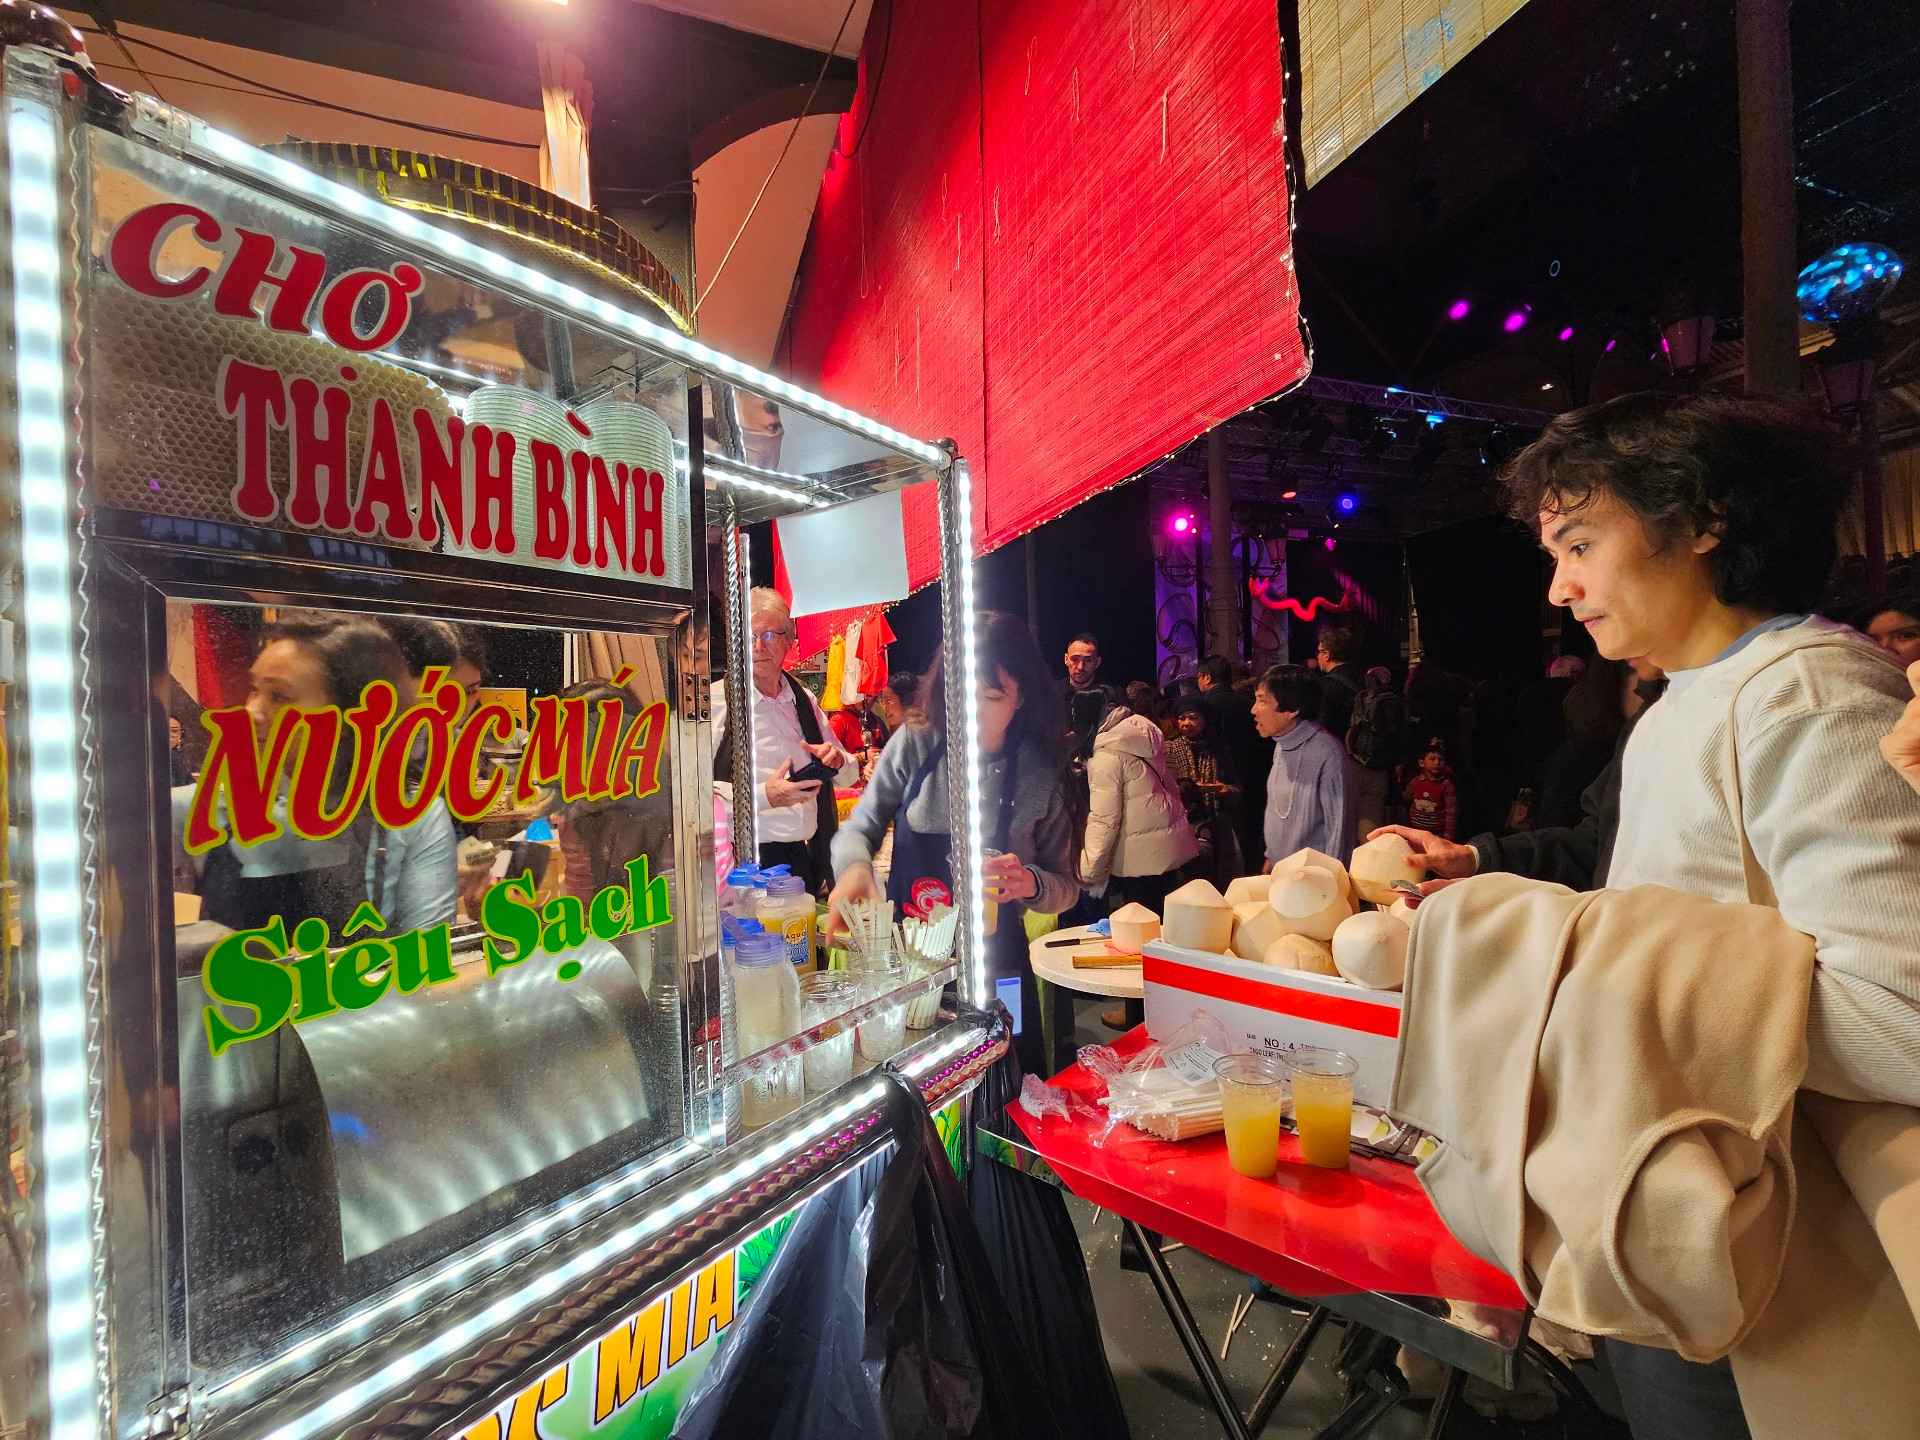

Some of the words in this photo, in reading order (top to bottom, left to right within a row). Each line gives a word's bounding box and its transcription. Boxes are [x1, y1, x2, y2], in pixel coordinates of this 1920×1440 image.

[218, 357, 518, 558] THANH
[528, 410, 668, 580] BÌNH
[185, 666, 516, 856] NƯỚC
[513, 663, 669, 806] MÍA
[202, 901, 458, 1057] Siêu
[481, 854, 673, 983] Sạch
